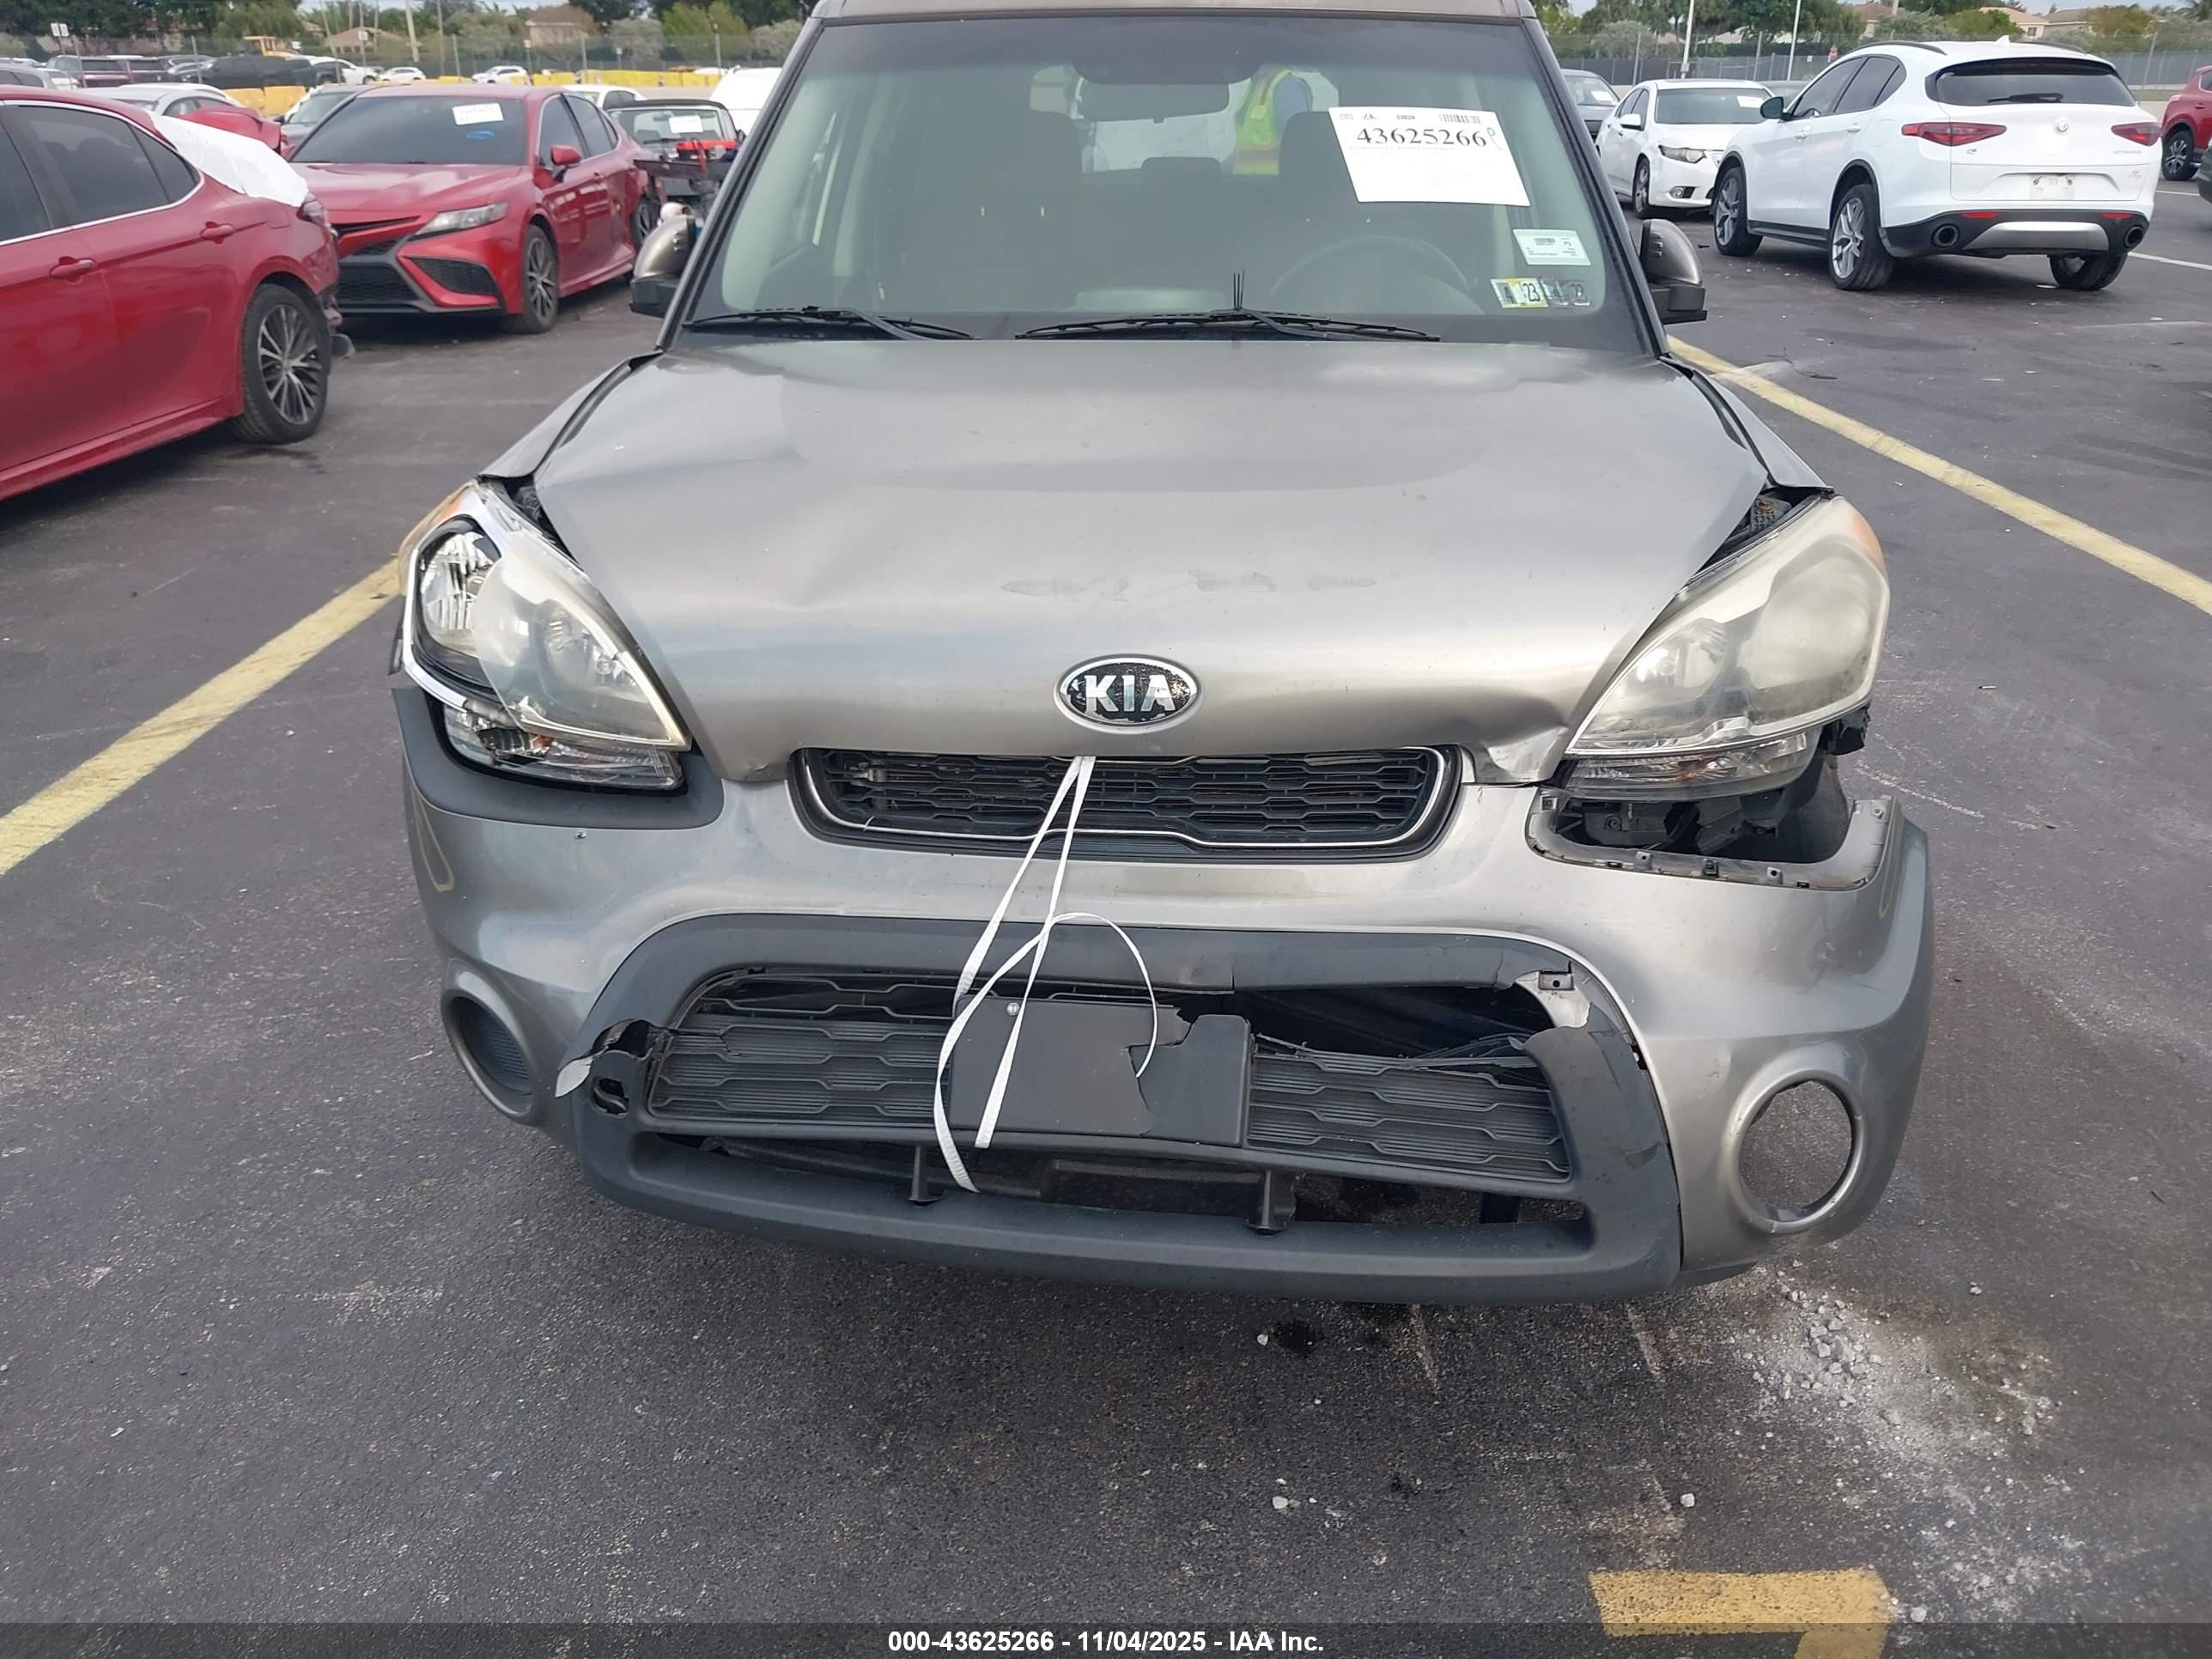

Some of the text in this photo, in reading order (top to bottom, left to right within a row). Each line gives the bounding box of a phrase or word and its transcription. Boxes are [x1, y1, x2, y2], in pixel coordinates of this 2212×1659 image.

[1357, 127, 1487, 147] 43625266
[1522, 283, 1540, 302] 23
[1084, 675, 1176, 712] KIA
